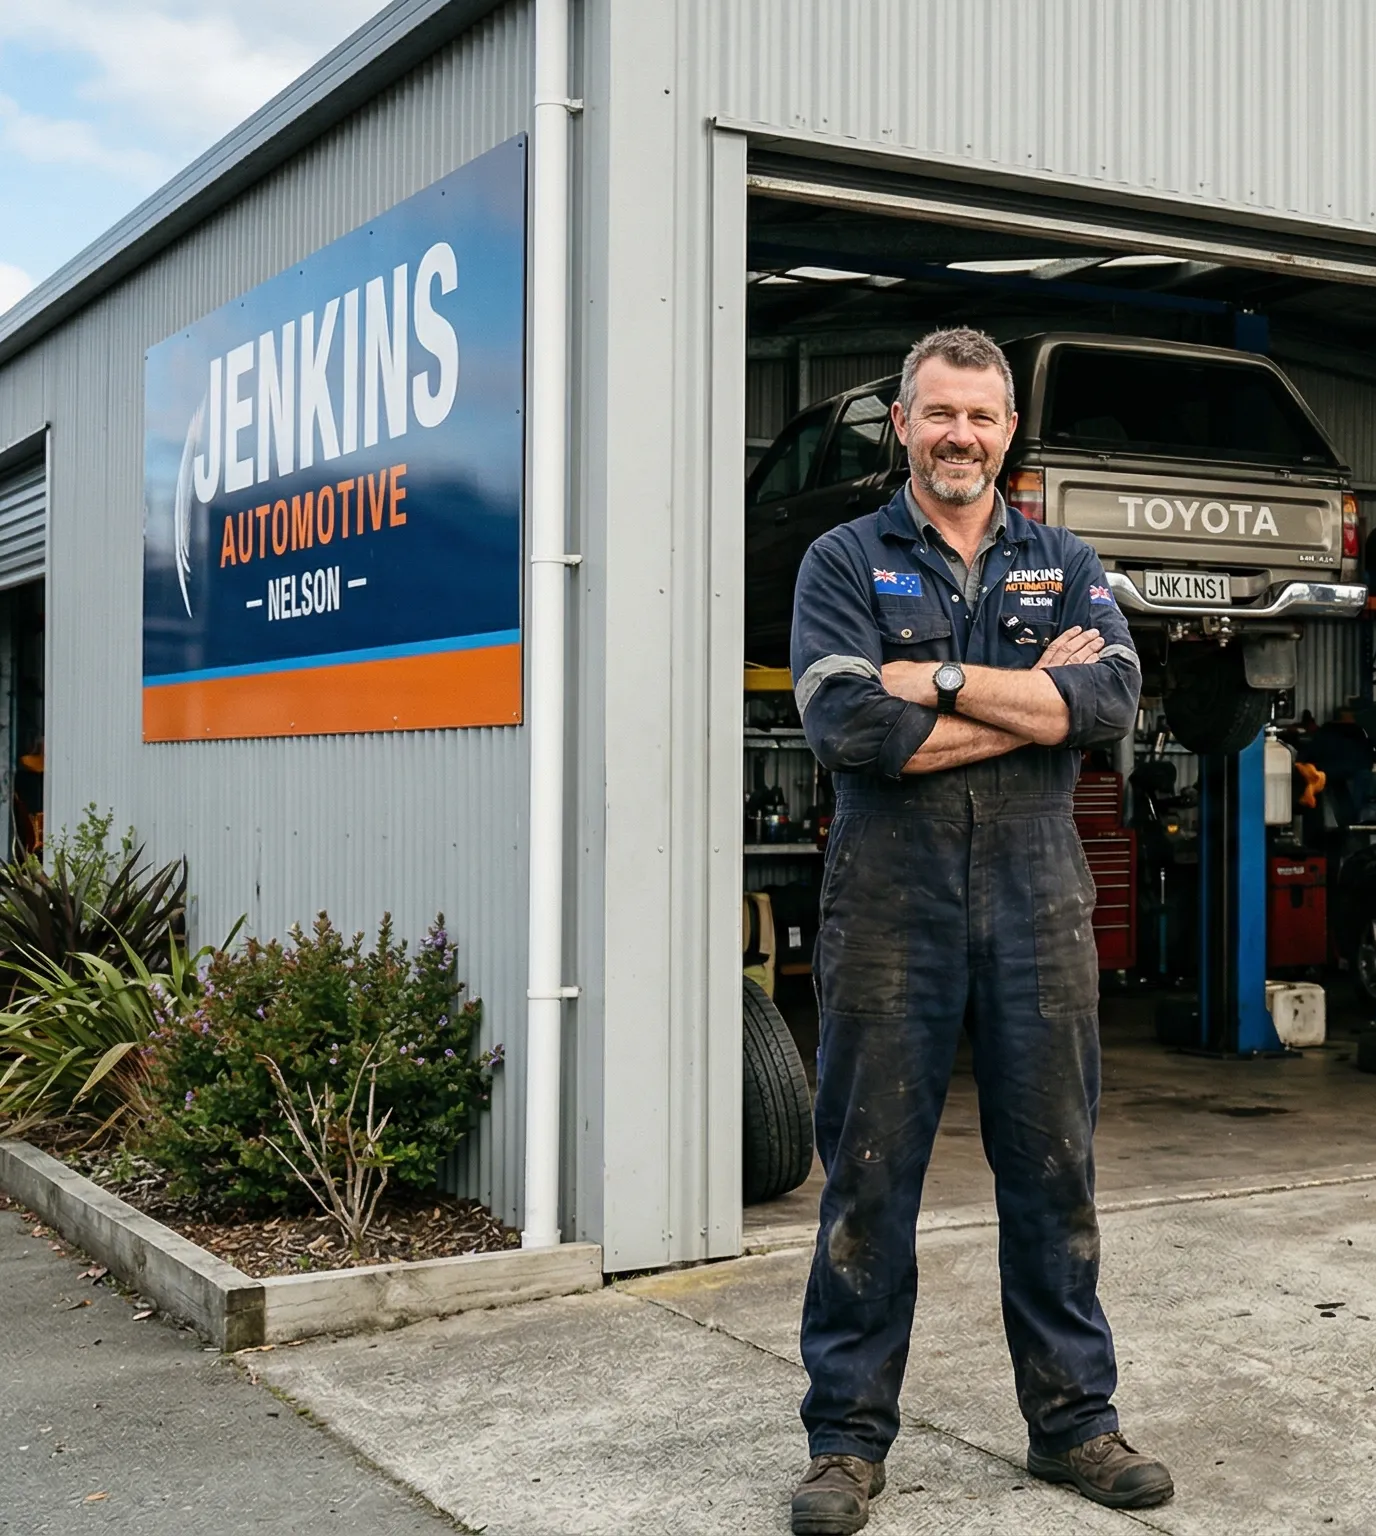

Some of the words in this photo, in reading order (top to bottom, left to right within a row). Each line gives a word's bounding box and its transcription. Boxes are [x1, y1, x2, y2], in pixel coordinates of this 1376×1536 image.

[193, 242, 459, 504] JENKINS
[219, 463, 408, 568] AUTOMOTIVE
[1117, 495, 1280, 537] TOYOTA
[267, 565, 341, 622] NELSON
[1005, 567, 1064, 583] JENKINS
[1148, 575, 1225, 600] JNKINS1
[1020, 597, 1053, 607] NELSON
